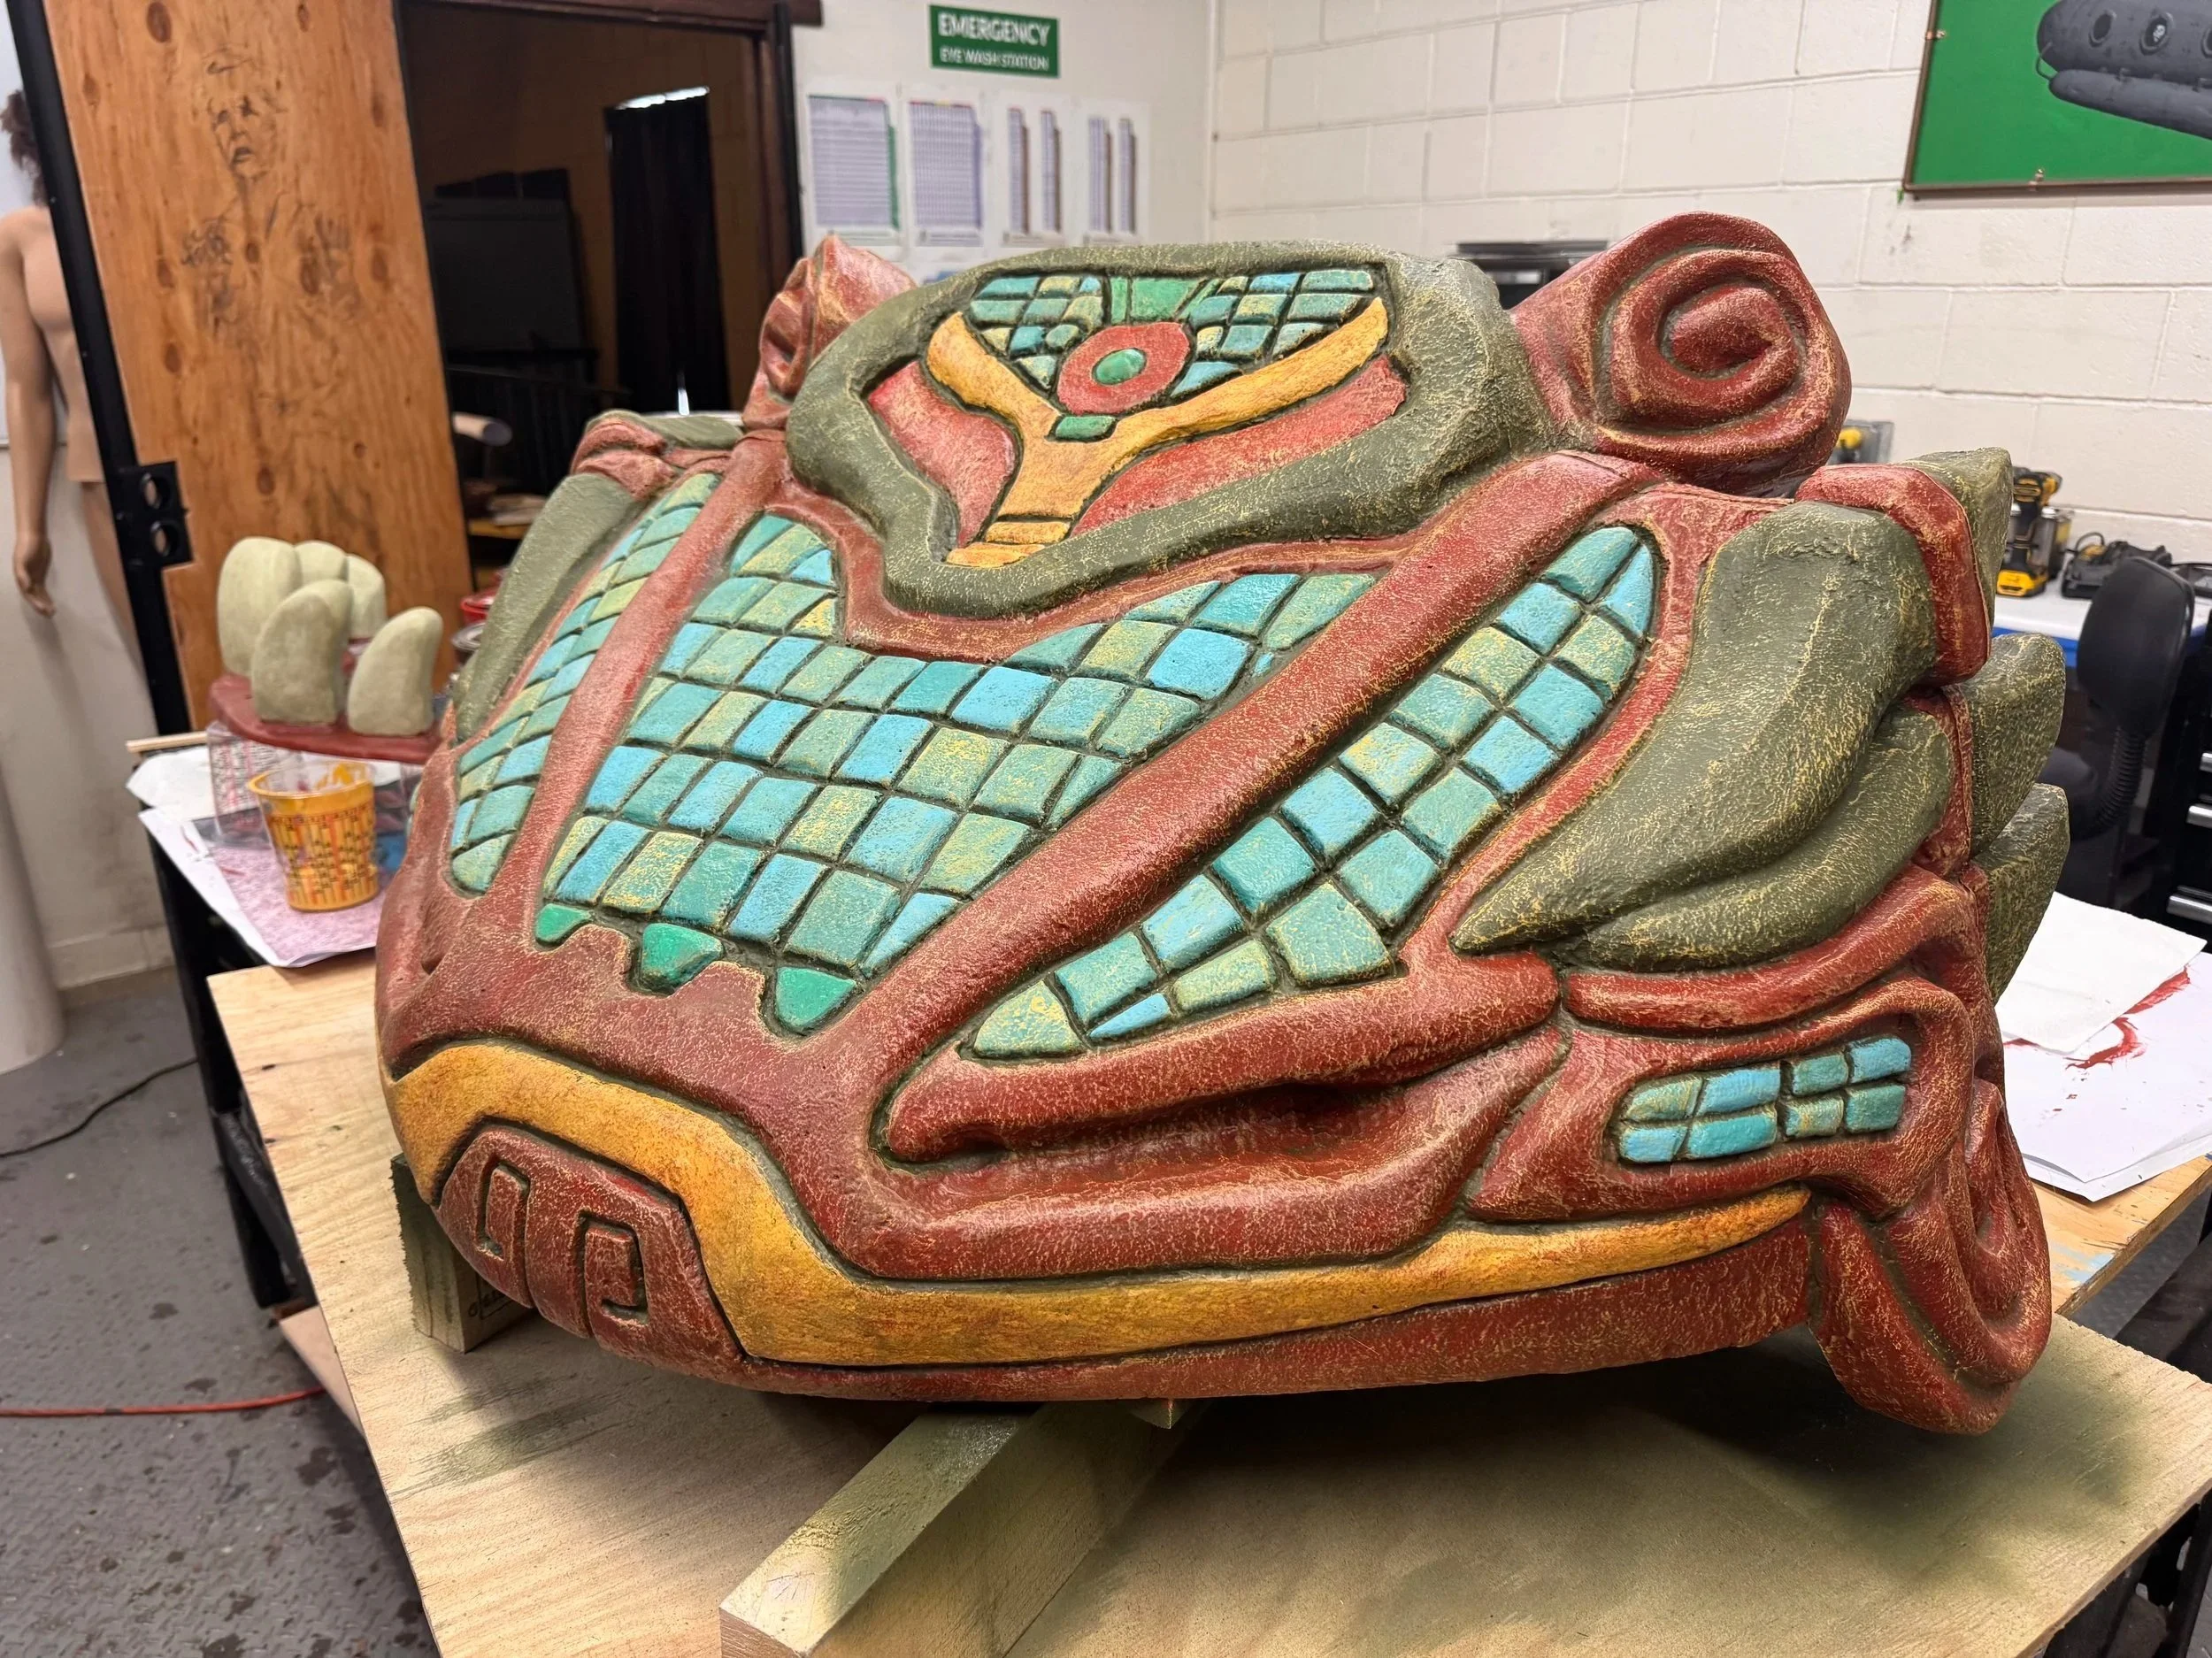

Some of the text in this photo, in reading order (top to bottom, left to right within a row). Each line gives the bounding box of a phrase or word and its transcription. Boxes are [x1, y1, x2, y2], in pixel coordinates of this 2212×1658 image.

[939, 12, 1050, 47] EMERGENCY
[940, 47, 1049, 71] EYE WASH STATION
